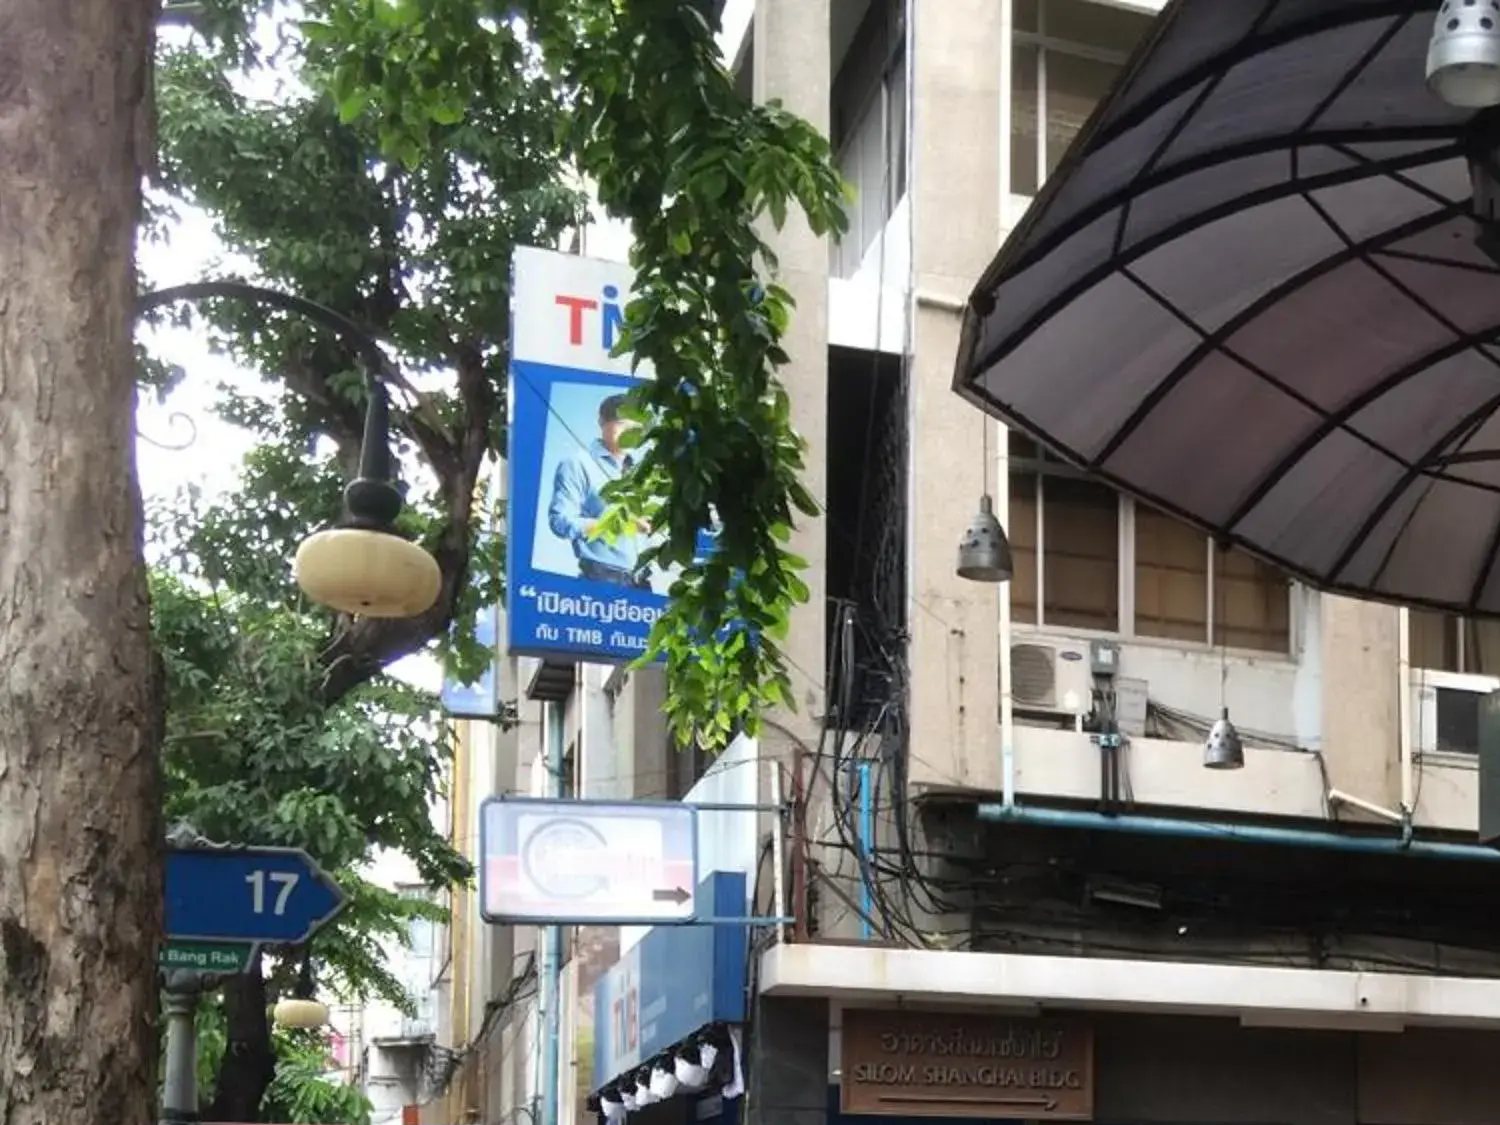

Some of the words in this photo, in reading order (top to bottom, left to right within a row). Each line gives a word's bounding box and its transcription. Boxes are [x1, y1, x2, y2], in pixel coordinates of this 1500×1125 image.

[245, 869, 300, 916] 17
[167, 949, 207, 965] Bang
[211, 950, 239, 964] Rak
[855, 1062, 916, 1084] SILOM
[924, 1064, 1024, 1086] SHANGHAI
